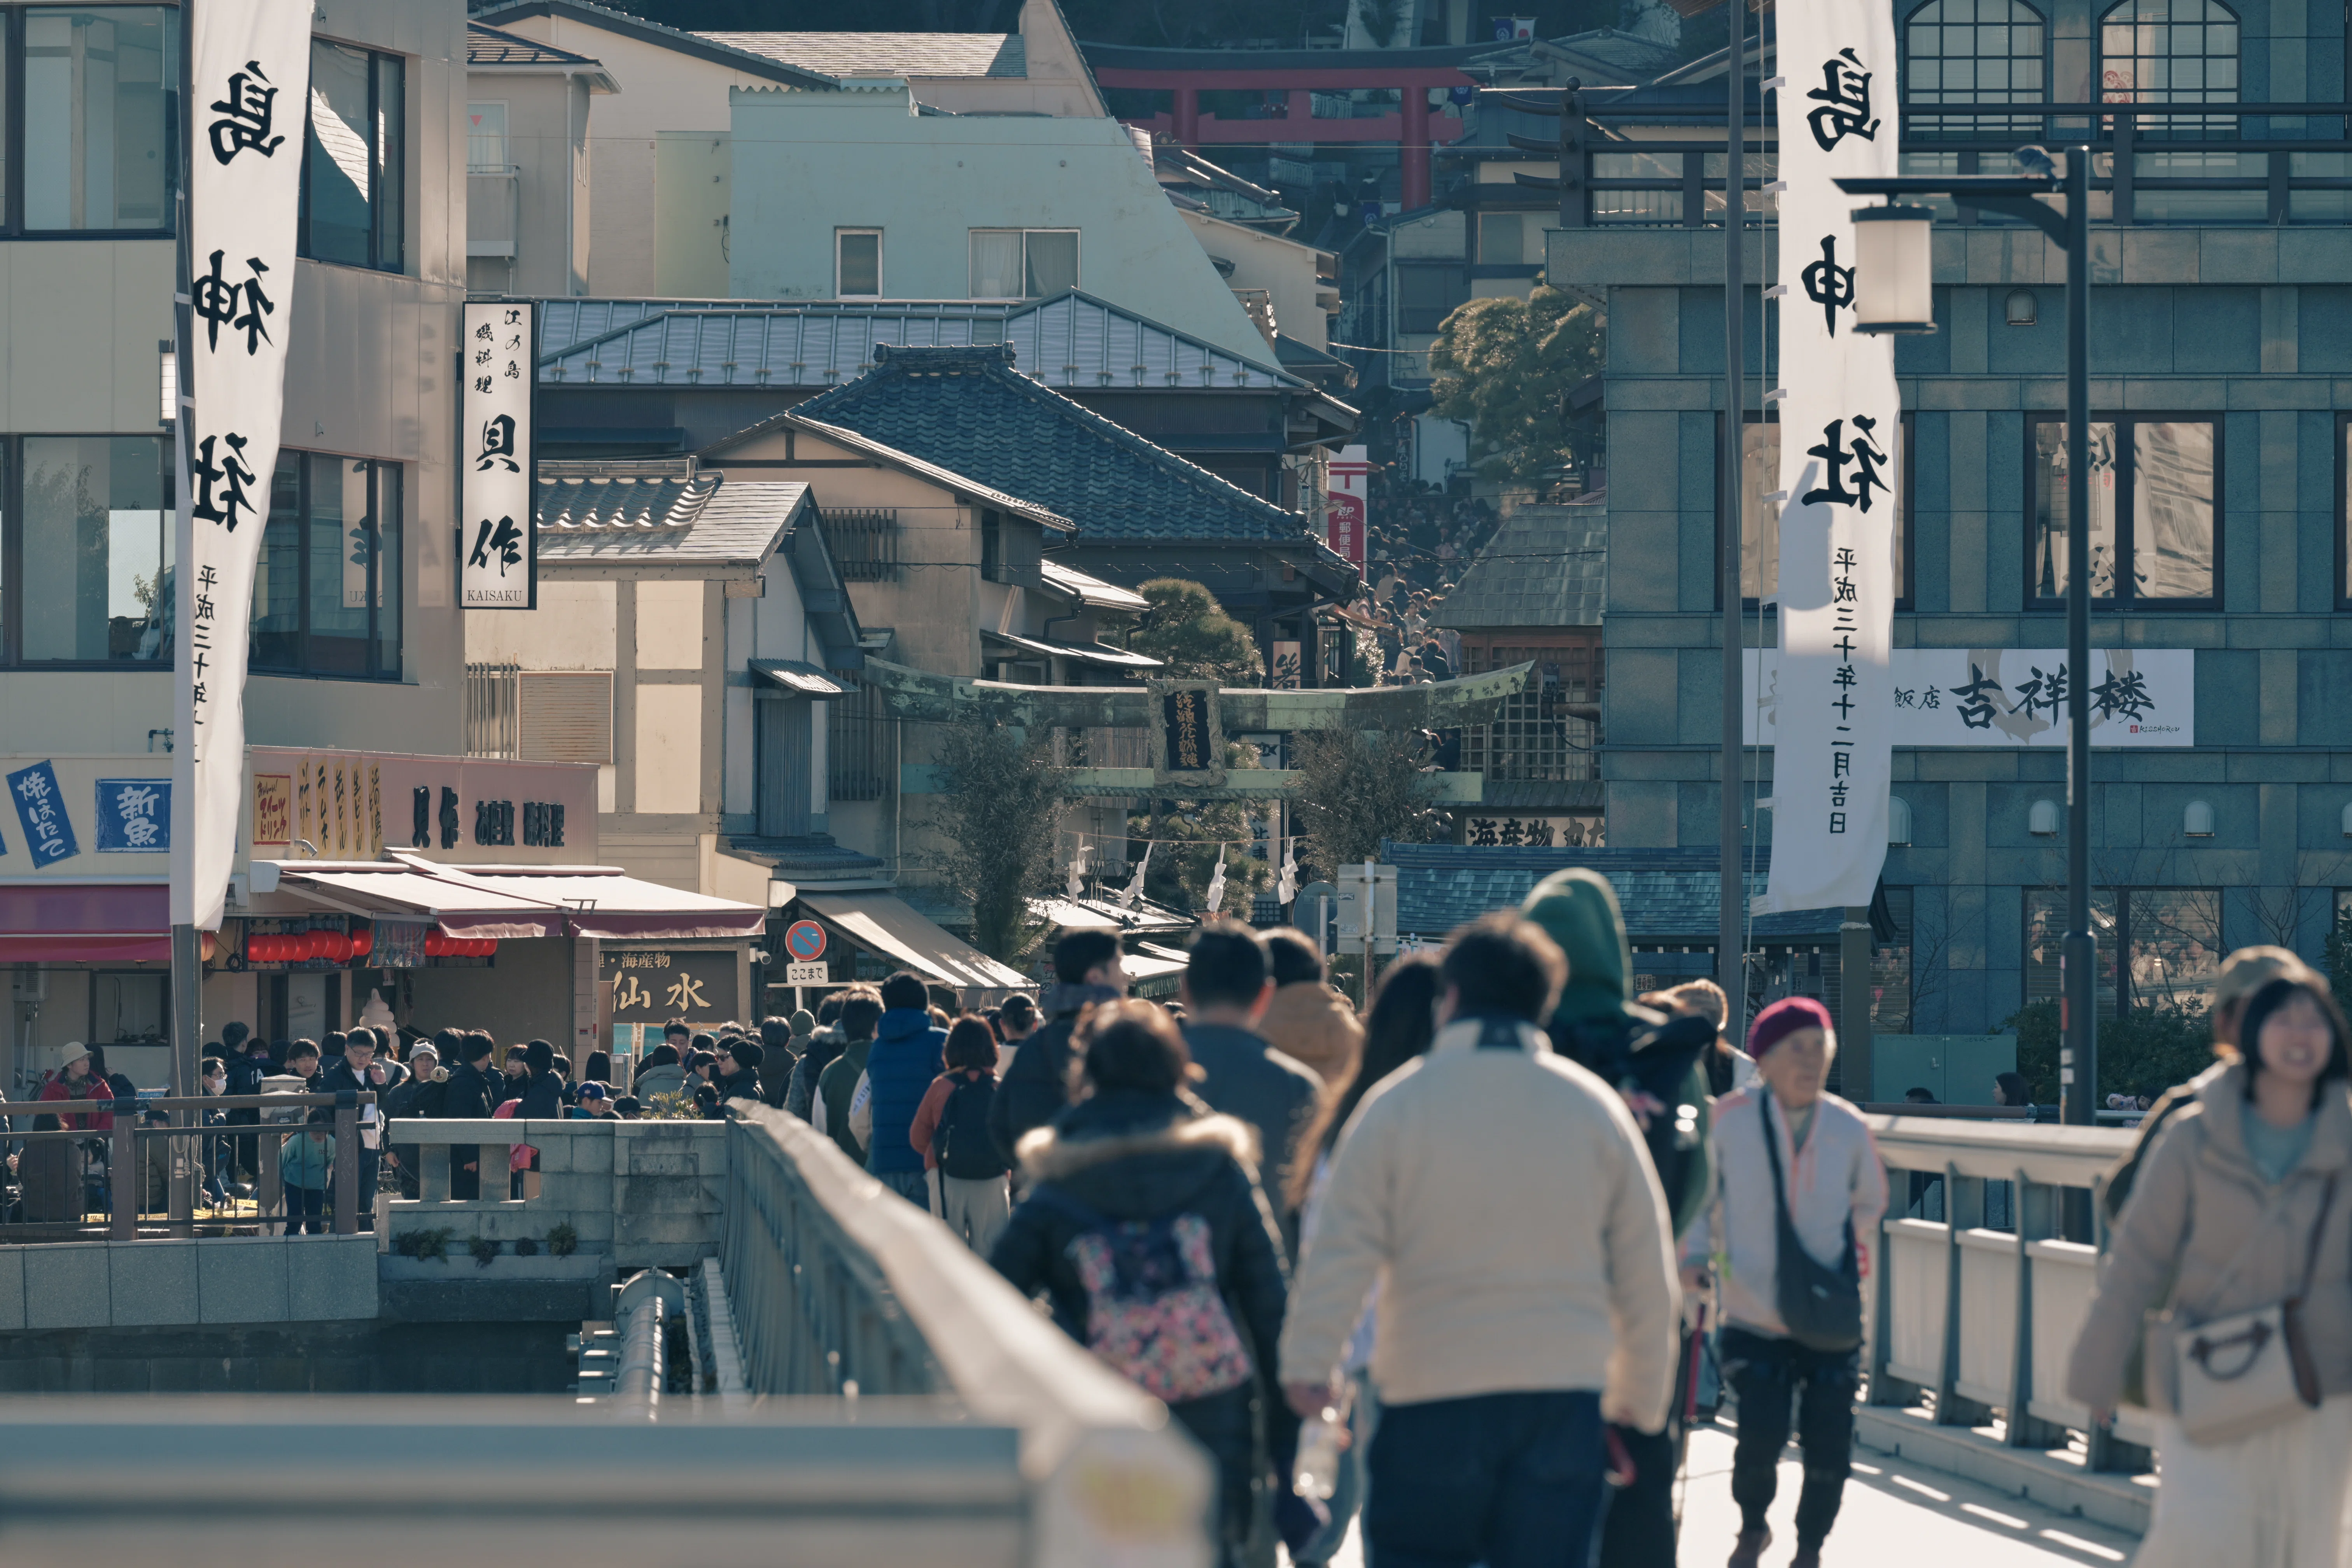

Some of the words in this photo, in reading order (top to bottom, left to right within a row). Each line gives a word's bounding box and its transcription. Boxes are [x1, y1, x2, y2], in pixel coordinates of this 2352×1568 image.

[475, 322, 494, 394] 磯料理
[504, 310, 522, 379] 江の島
[467, 414, 523, 578] 貝作
[1339, 522, 1351, 558] 郵便局
[467, 590, 522, 602] KAISAKU
[1895, 684, 1941, 710] 飯店
[1949, 663, 2155, 729] 吉祥楼
[2140, 725, 2179, 734] KISSHOROU
[17, 772, 65, 856] 焼ほたて
[260, 795, 286, 819] スイーツ
[260, 816, 287, 840] ドリンク
[318, 765, 328, 850] ラムネ
[354, 768, 362, 852] 生ビール
[371, 768, 381, 839] 江の島
[412, 786, 458, 849] 貝作
[1467, 818, 1555, 847] 海産物
[613, 971, 712, 1012] 仙水
[791, 967, 823, 980] ここまで
